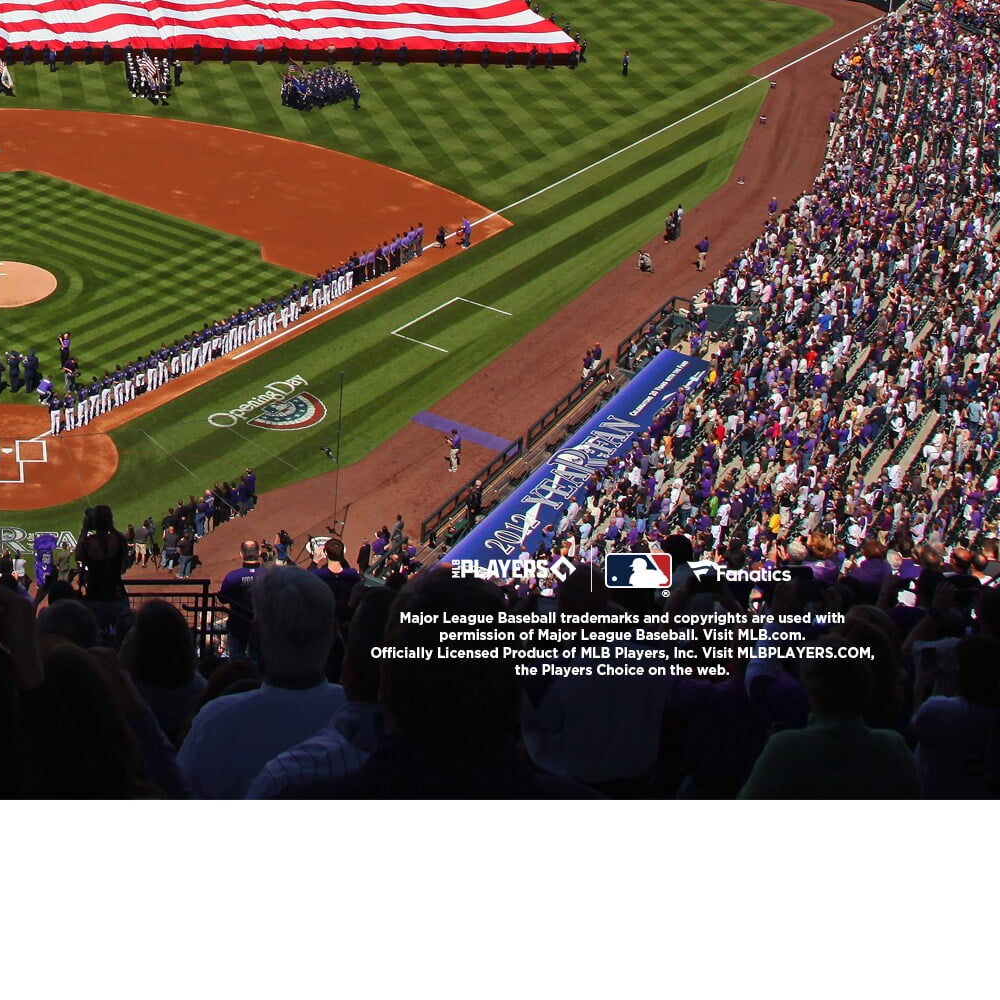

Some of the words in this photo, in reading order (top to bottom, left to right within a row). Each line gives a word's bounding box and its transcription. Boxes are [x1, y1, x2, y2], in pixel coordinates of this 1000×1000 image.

[484, 513, 541, 555] 2012
[520, 447, 608, 510] YEAR
[590, 414, 641, 460] FAN
